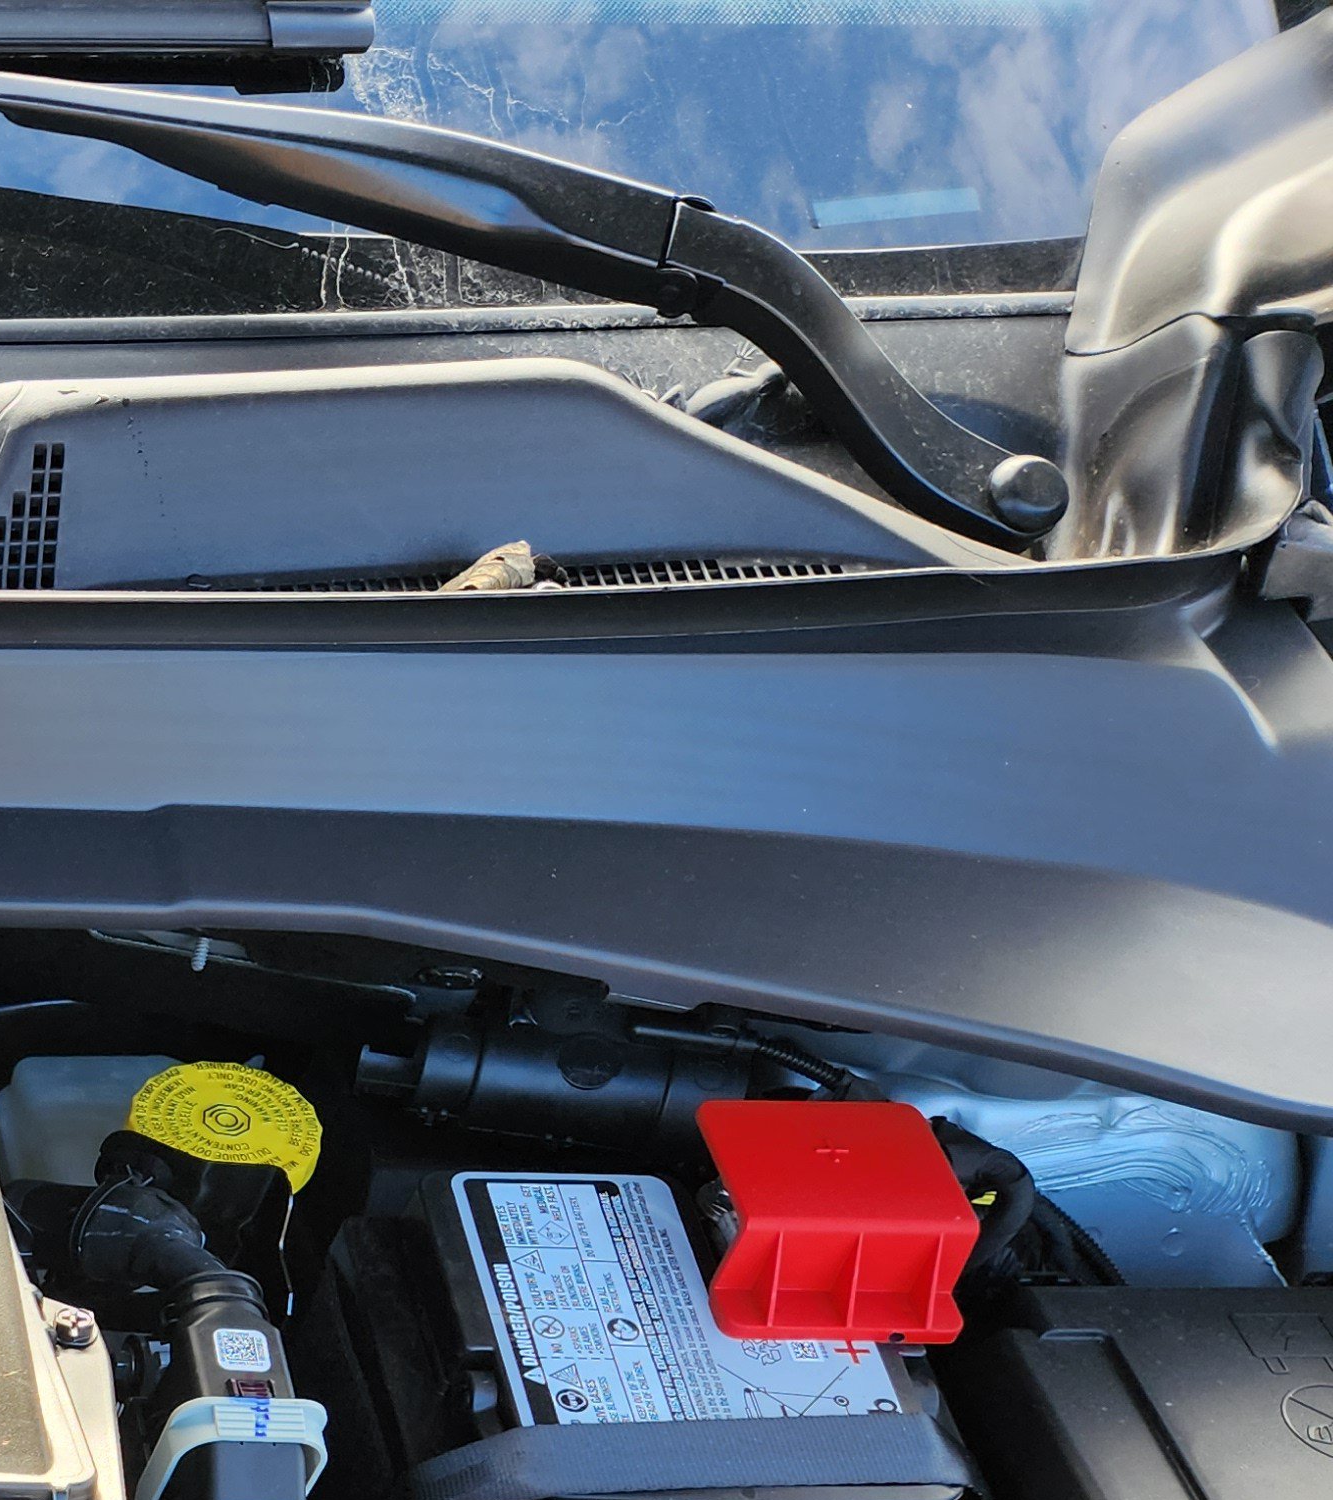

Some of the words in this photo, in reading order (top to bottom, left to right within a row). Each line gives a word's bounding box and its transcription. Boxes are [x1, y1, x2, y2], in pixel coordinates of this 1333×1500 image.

[208, 1072, 234, 1081] ONLY
[238, 1076, 258, 1086] USE
[153, 1078, 186, 1115] UNIQUEMENT
[295, 1097, 313, 1115] FROM
[165, 1099, 185, 1140] PROVENANT
[307, 1118, 318, 1137] FLUID
[186, 1129, 250, 1151] CONTENANT
[289, 1120, 303, 1146] BEFORE
[183, 1139, 192, 1147] 3
[299, 1142, 314, 1156] DOT
[191, 1146, 212, 1157] DOT
[215, 1152, 258, 1161] LIQUIDE
[256, 1147, 272, 1157] DU
[520, 1185, 532, 1196] GET
[531, 1186, 549, 1213] MEDICAL
[495, 1205, 508, 1221] EYES
[549, 1204, 563, 1220] HELP
[505, 1201, 527, 1244] IMMEDIATELY
[526, 1229, 539, 1244] WITH
[596, 1287, 607, 1295] ALL
[492, 1263, 538, 1366] DANGER/POISON
